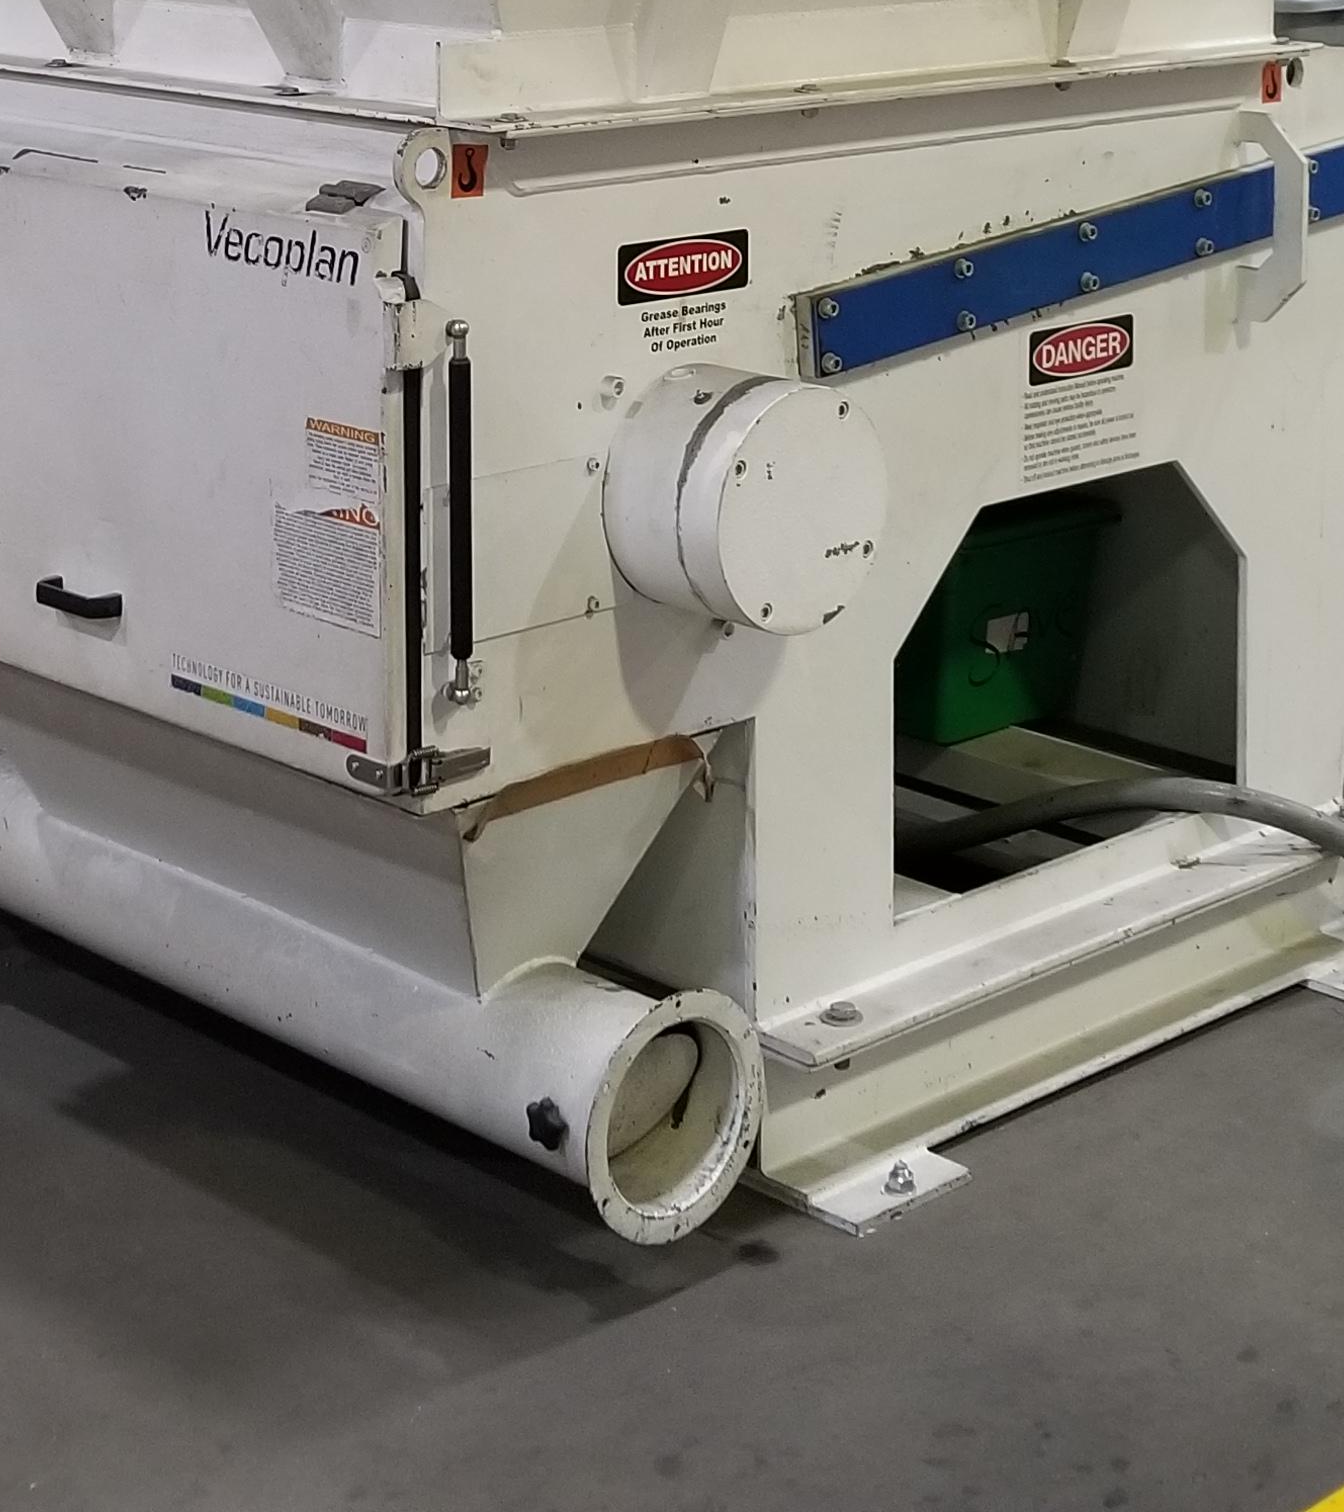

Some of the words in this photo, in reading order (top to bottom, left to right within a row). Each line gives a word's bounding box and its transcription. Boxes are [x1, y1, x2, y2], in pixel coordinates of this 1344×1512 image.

[205, 209, 360, 288] Vecoplan
[634, 248, 733, 282] ATTENTION
[640, 308, 679, 323] Grease
[681, 301, 727, 317] Bearings
[643, 325, 671, 339] After
[672, 321, 697, 334] First
[699, 316, 725, 330] Hour
[650, 341, 663, 353] Of
[666, 334, 717, 351] Operation
[1041, 330, 1122, 369] DANGER
[309, 418, 376, 444] WARNING
[172, 652, 224, 684] TECHNOLOGY
[225, 670, 243, 690] FOR
[245, 677, 252, 695] A
[254, 680, 312, 715] SUSTAINABLE
[315, 700, 369, 732] TOMORROW
